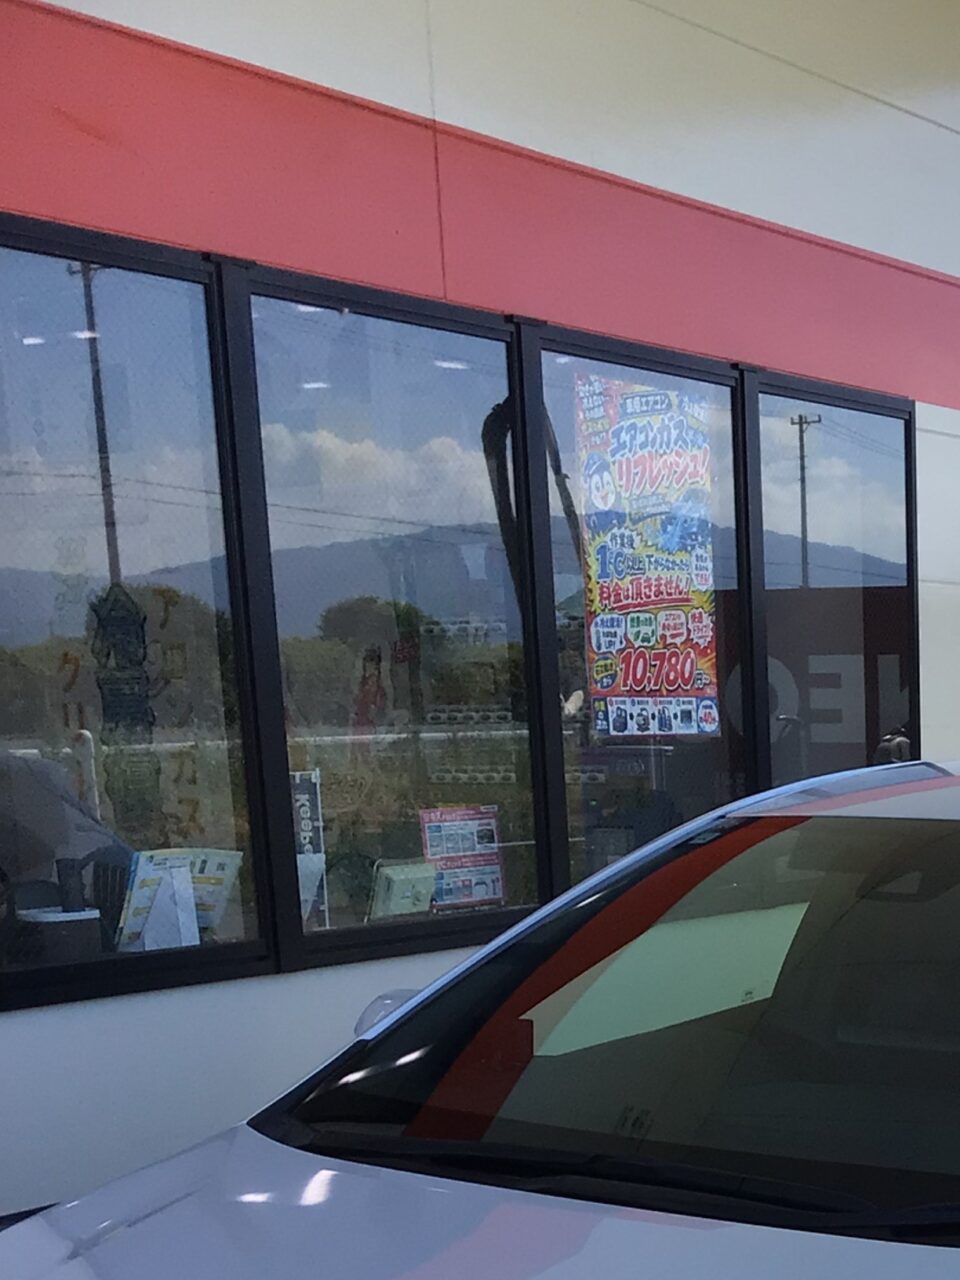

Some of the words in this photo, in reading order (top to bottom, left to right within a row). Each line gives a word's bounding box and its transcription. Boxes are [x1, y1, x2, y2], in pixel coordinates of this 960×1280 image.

[616, 447, 710, 495] リフレッシュ!
